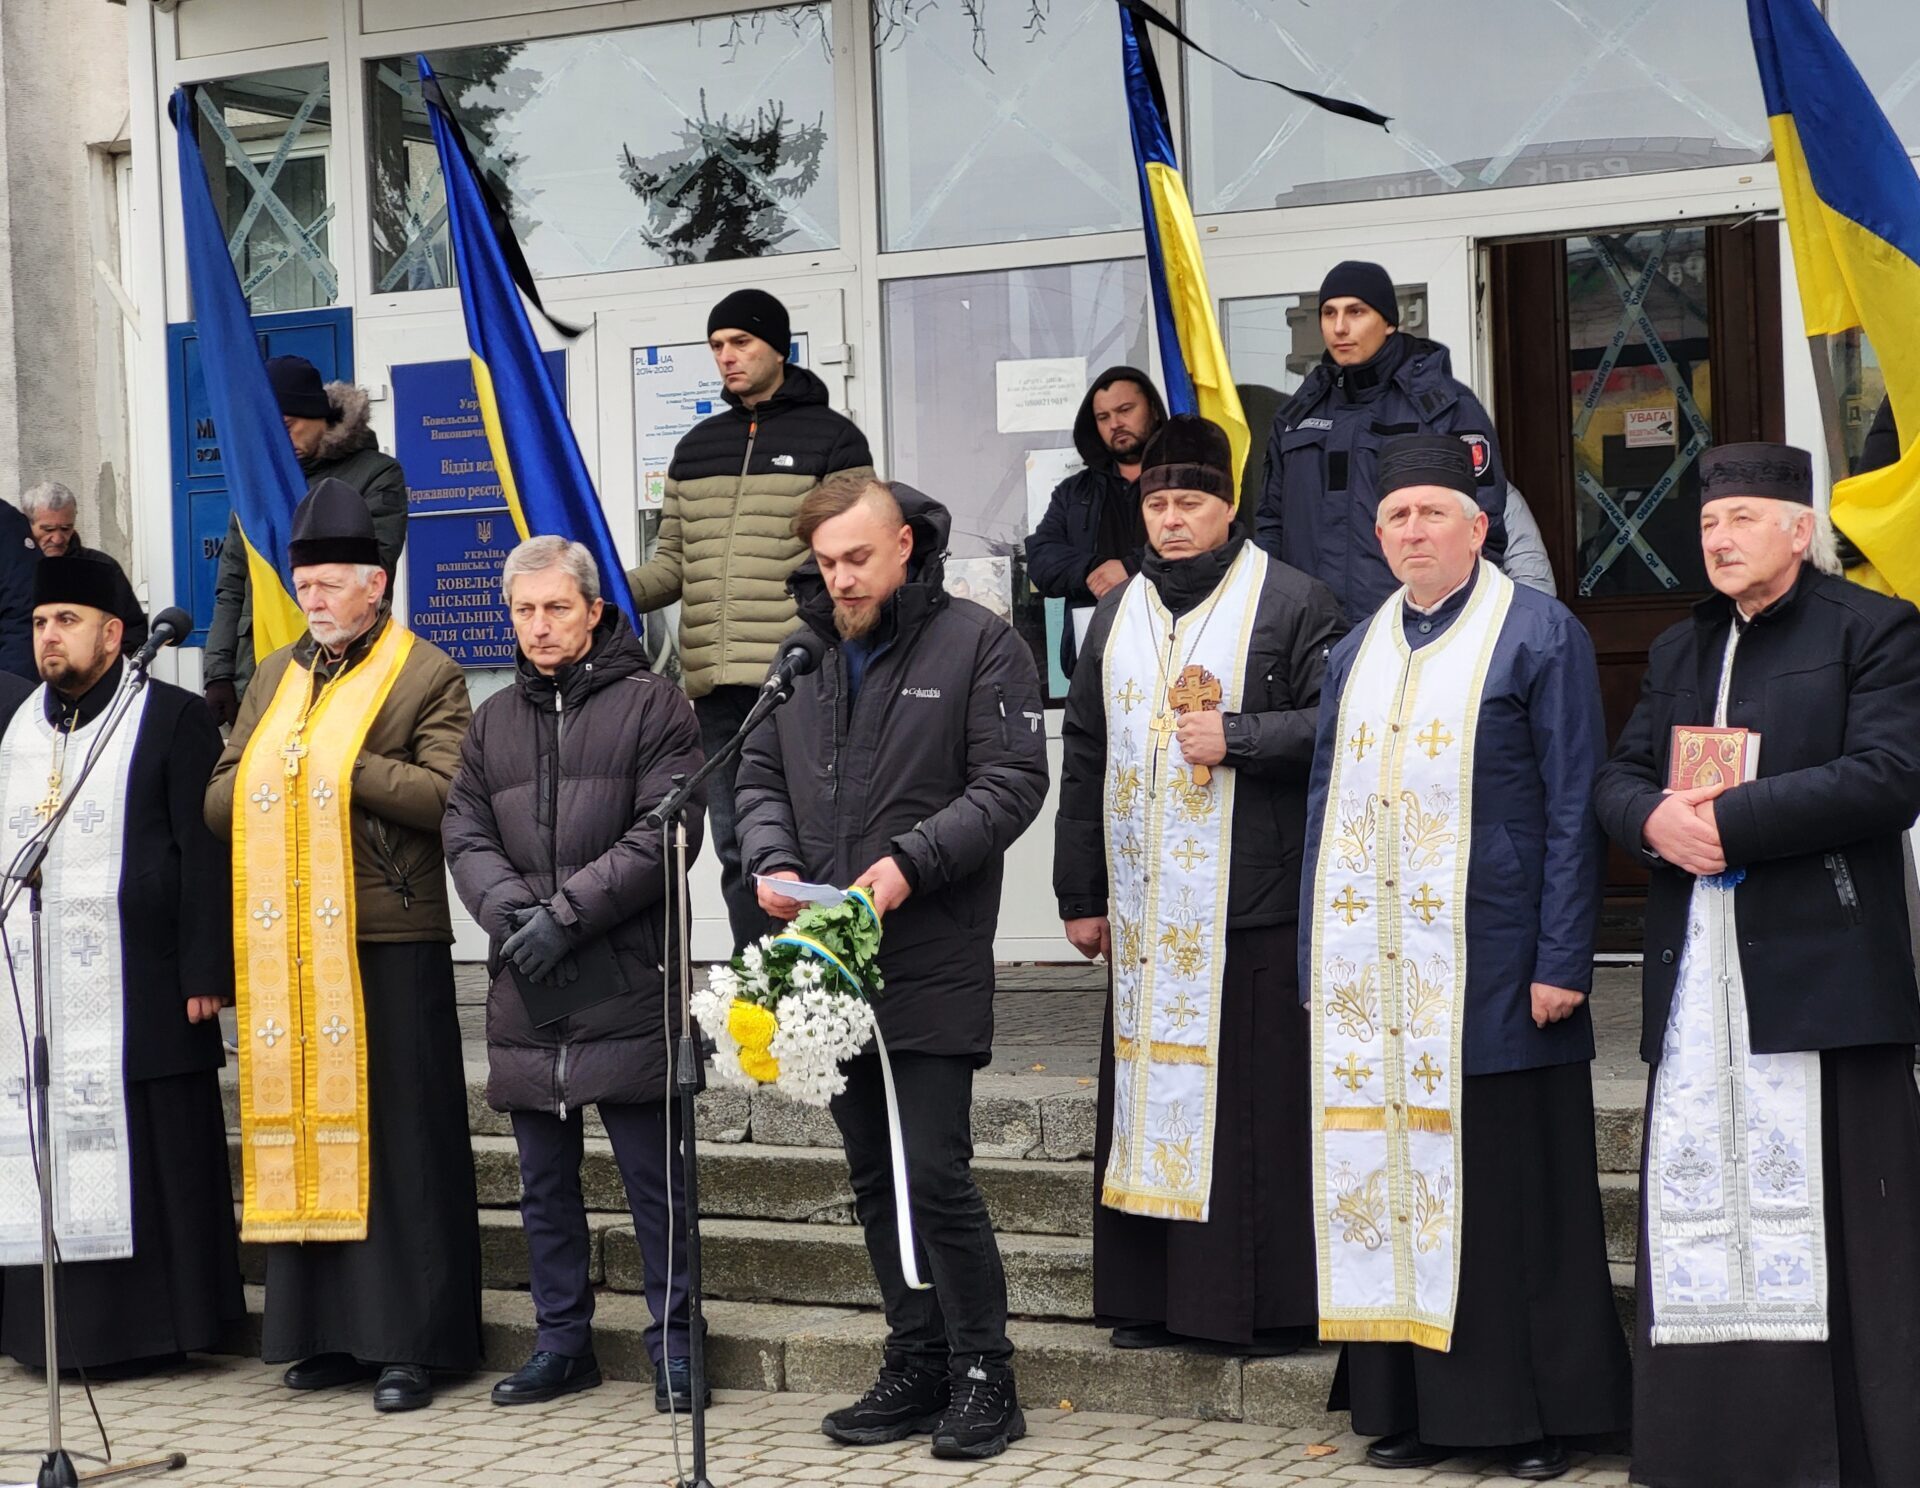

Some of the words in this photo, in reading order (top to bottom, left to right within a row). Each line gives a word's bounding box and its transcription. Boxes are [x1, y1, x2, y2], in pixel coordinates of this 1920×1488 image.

[459, 398, 480, 411] Укр
[422, 415, 479, 427] Ковельська
[441, 458, 474, 475] Відділ
[477, 460, 496, 474] вед
[1636, 477, 1672, 520] ОБЕРЕЖНО
[464, 548, 506, 560] УКРАЇНА
[436, 561, 491, 573] ВОЛИНСЬКА
[429, 590, 491, 608] МІСЬКИЙ
[414, 610, 505, 626] СОЦІАЛЬНИХ
[430, 629, 458, 644] ДЛЯ
[449, 645, 468, 658] ТА
[909, 686, 941, 697] Columbia
